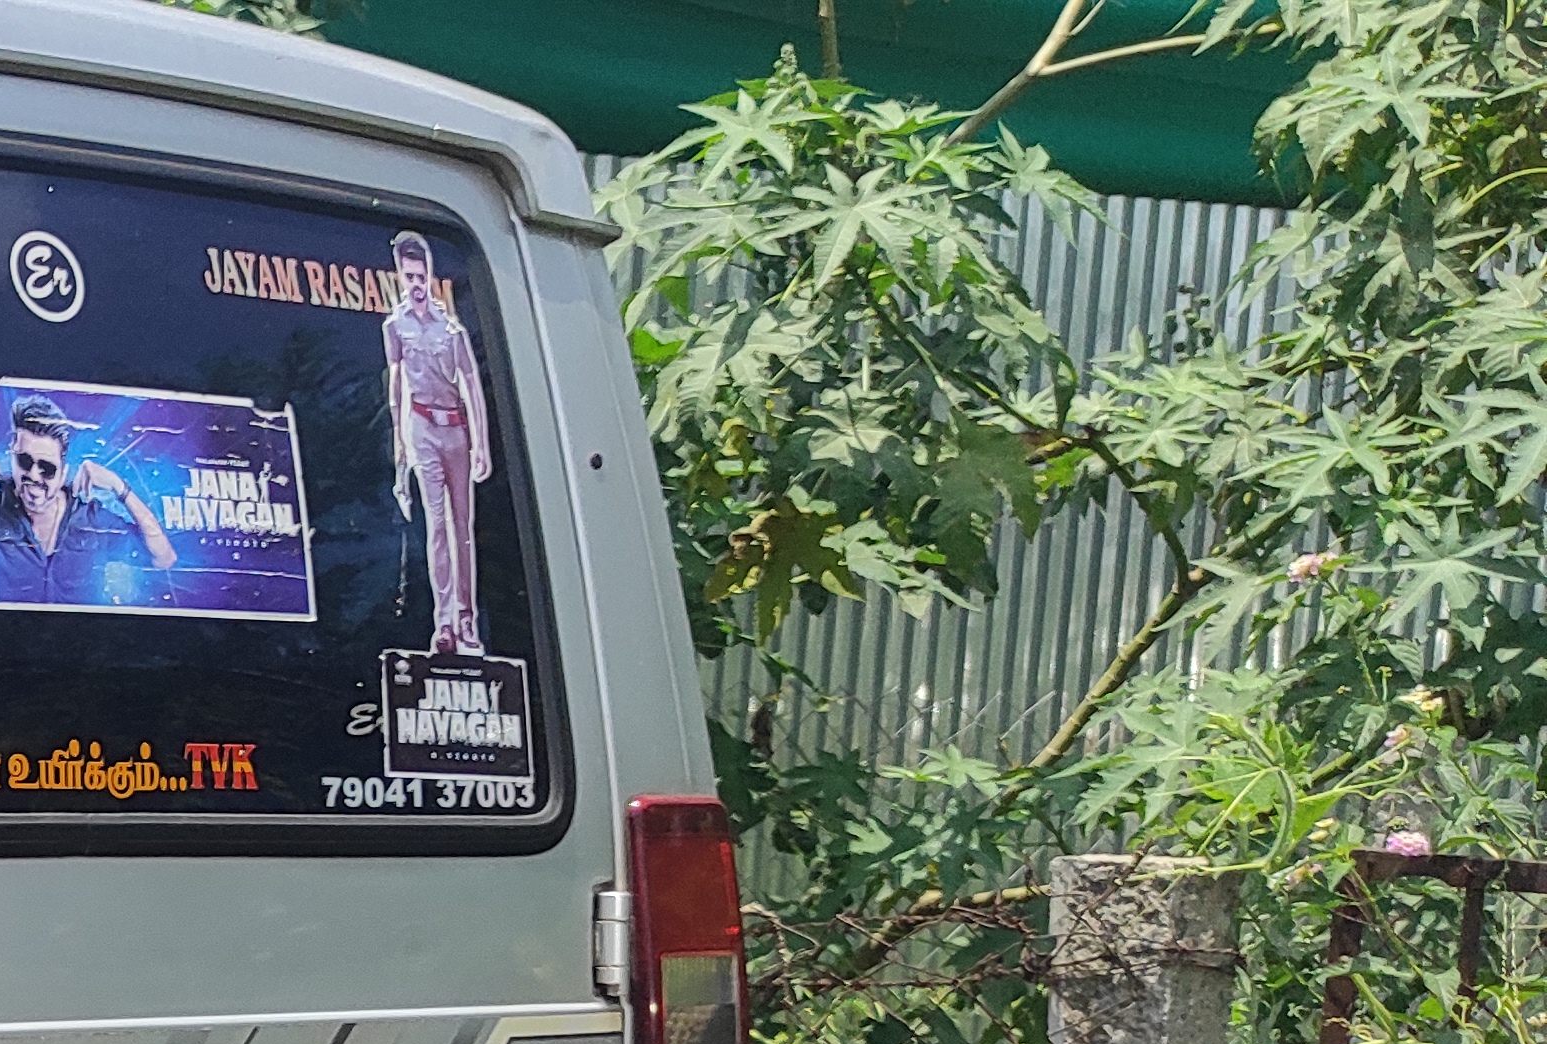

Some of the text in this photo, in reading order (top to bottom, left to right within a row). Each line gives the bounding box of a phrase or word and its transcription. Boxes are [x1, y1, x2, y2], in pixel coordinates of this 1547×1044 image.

[24, 246, 74, 299] Er
[204, 247, 457, 317] JAYAM RASANM
[184, 467, 259, 503] JANA
[161, 495, 299, 537] NAYAGAN
[418, 678, 490, 713] JANA
[395, 708, 523, 749] NAYAGAN
[183, 743, 259, 790] TVK
[320, 776, 536, 809] 79041 37003
